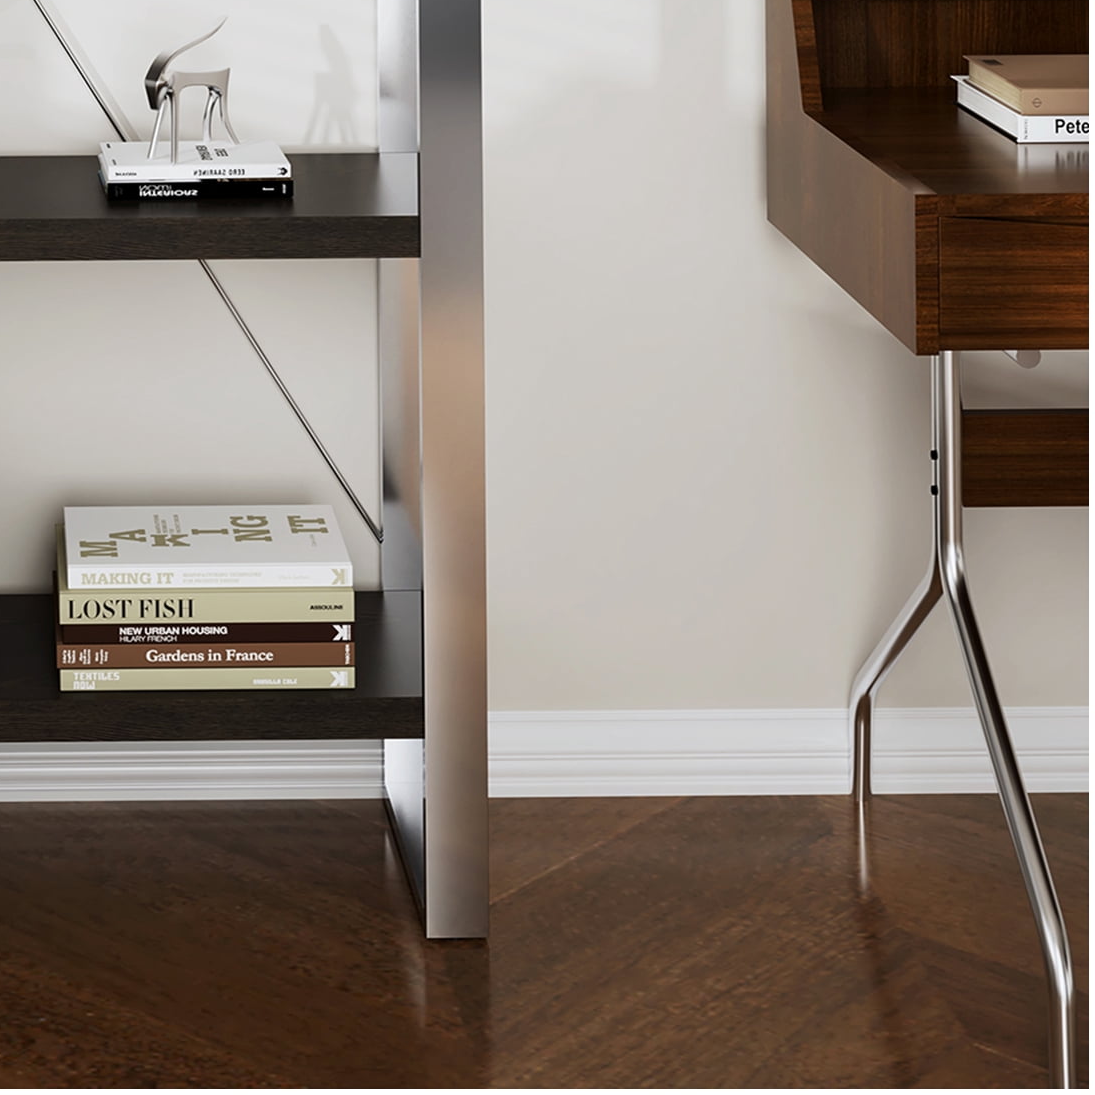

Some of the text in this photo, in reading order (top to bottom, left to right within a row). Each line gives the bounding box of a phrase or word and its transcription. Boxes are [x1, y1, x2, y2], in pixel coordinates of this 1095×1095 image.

[1055, 118, 1089, 134] Pete
[287, 515, 329, 534] IT
[81, 572, 152, 585] MAKING
[156, 572, 174, 585] IT
[68, 598, 194, 619] LOST FISH
[119, 626, 228, 636] NEW URBAN HOUSING
[145, 648, 274, 663] Gardens in France
[73, 671, 120, 681] TEXTILES
